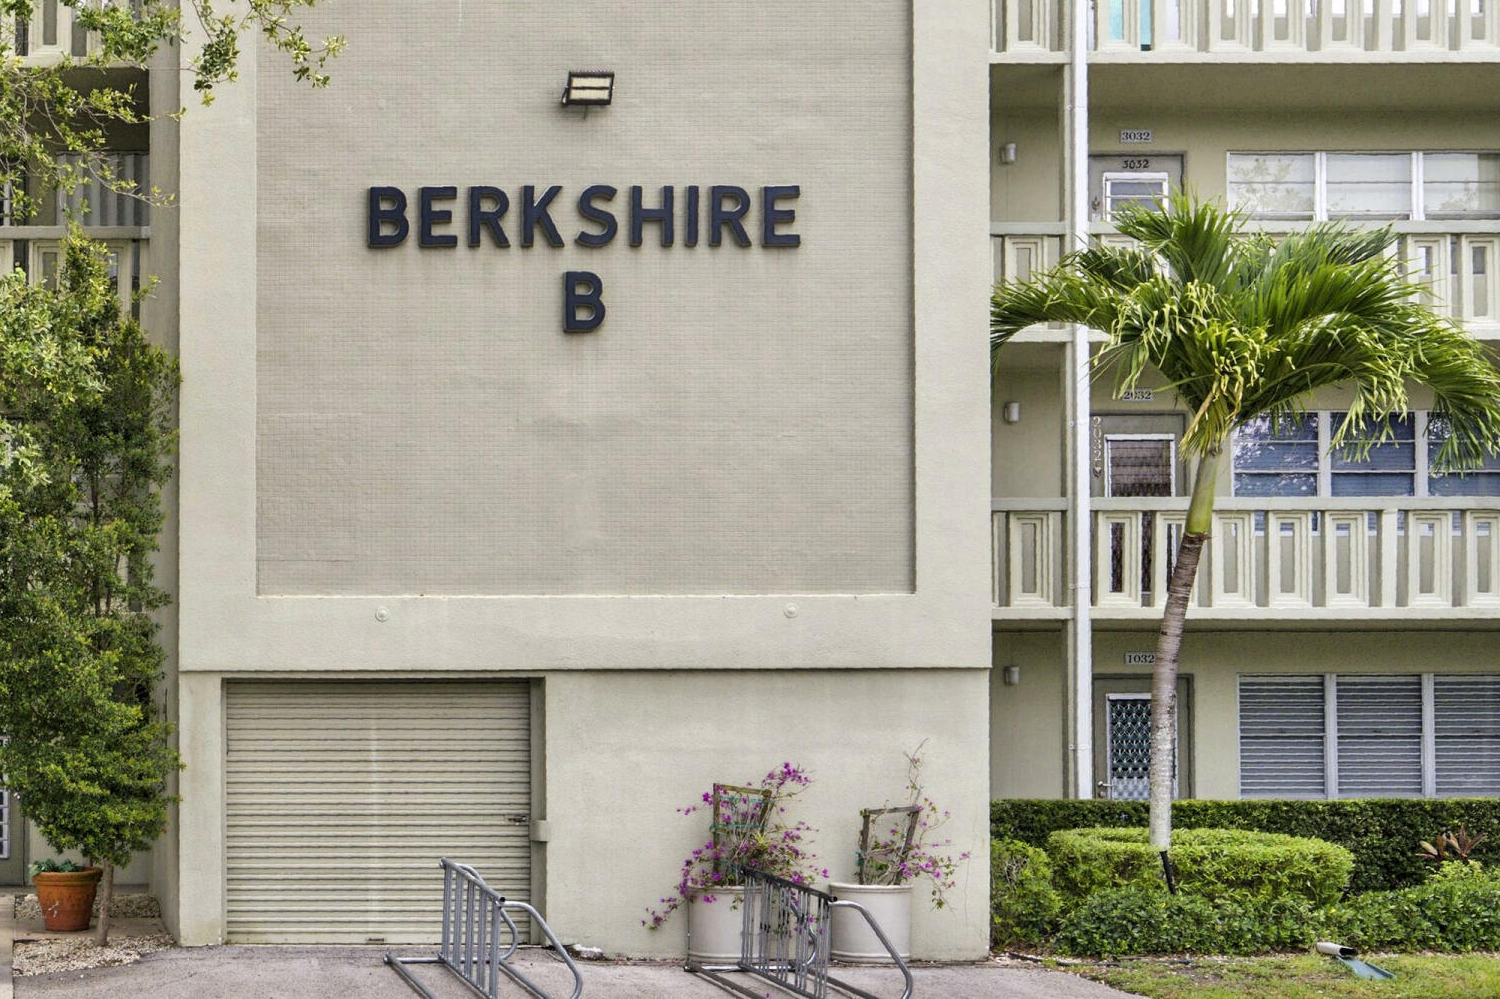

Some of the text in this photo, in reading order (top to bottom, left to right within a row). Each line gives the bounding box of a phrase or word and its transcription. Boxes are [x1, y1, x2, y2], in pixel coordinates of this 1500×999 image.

[1122, 131, 1150, 141] 3032
[367, 185, 801, 248] BERKSHIRE
[563, 271, 606, 333] B
[1128, 654, 1155, 664] 1032
